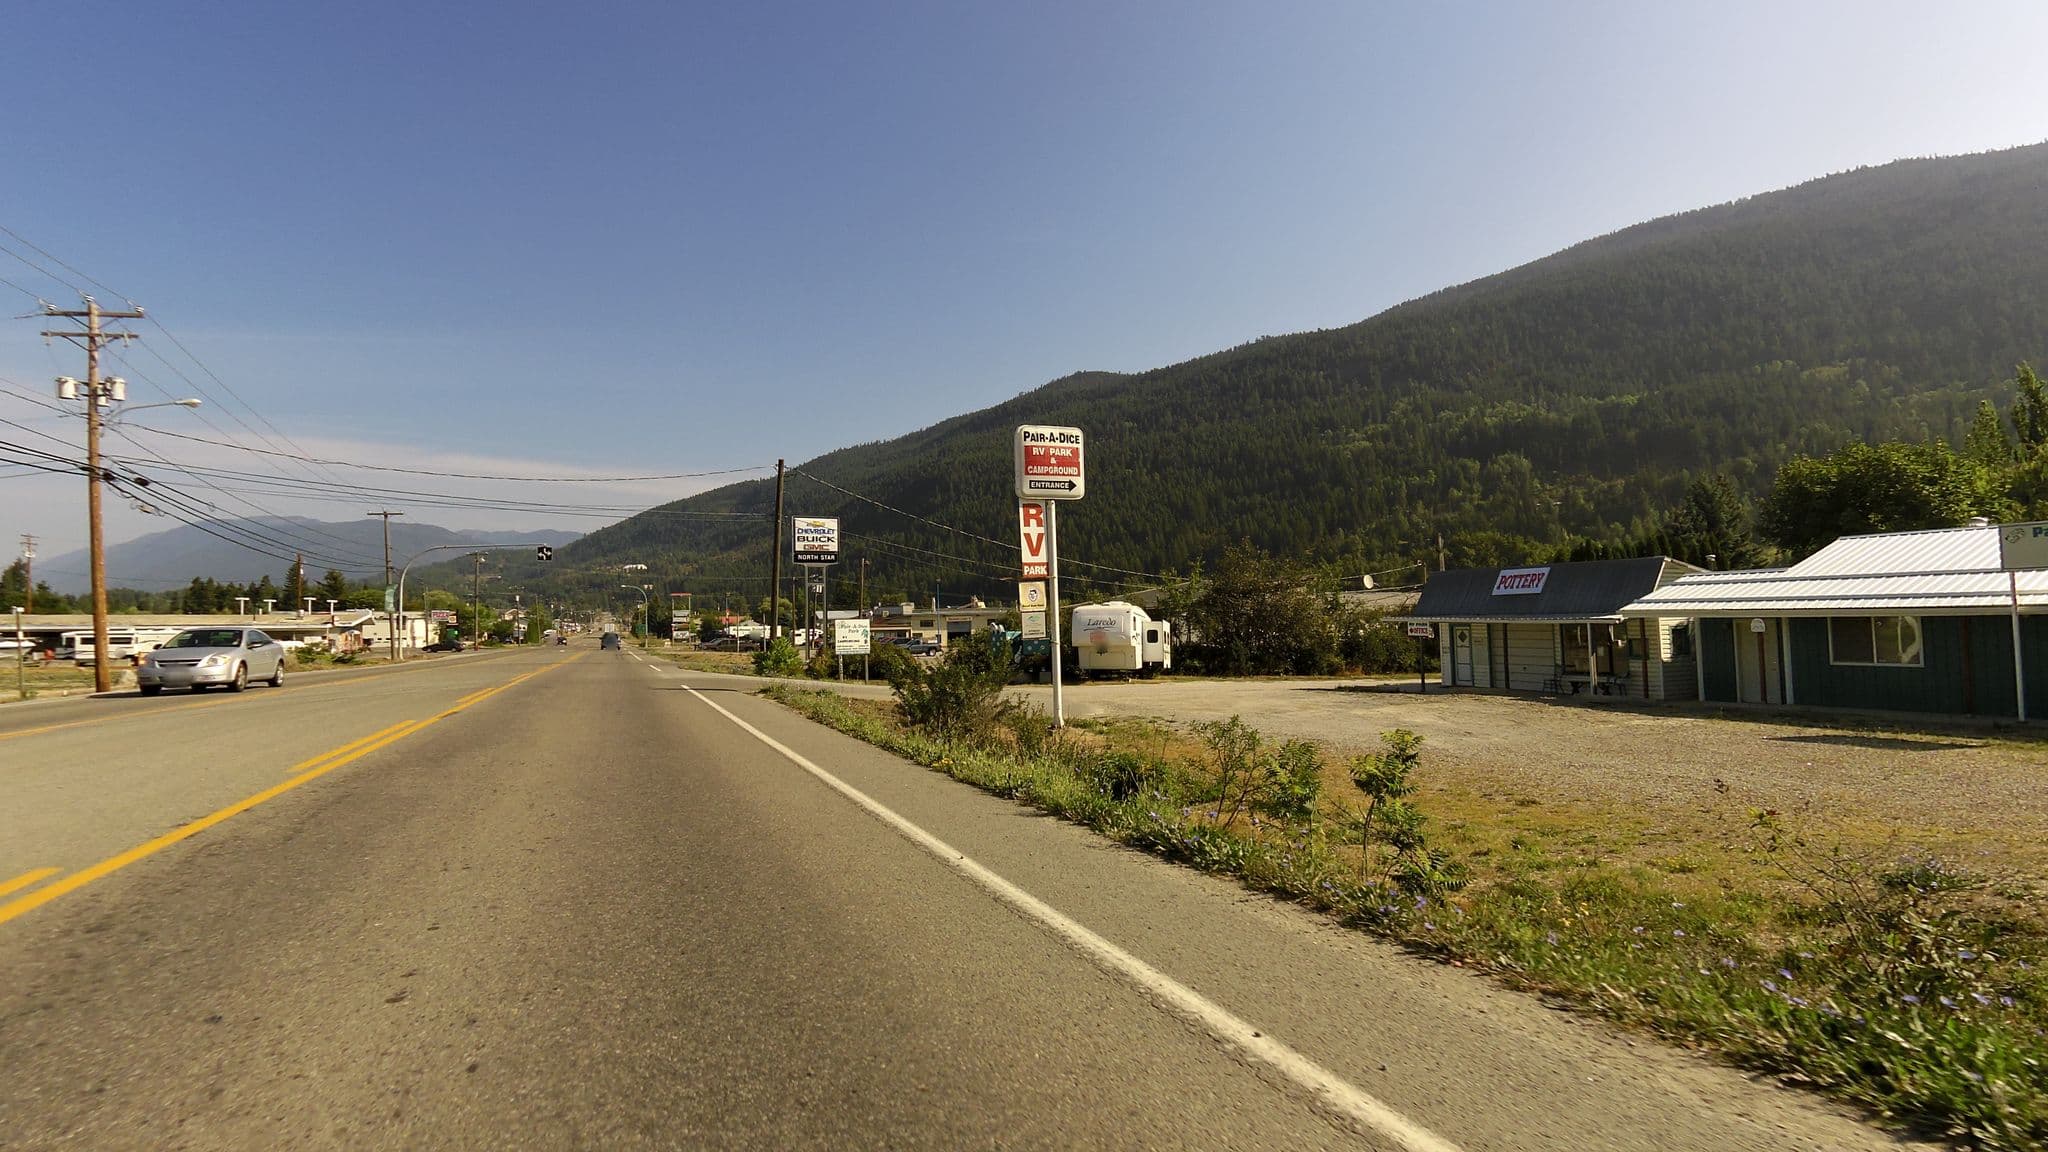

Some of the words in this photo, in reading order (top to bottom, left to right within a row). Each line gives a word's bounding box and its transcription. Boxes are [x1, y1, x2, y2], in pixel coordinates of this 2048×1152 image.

[1032, 447, 1045, 456] RV
[1049, 447, 1073, 457] PARK
[1027, 465, 1078, 475] CAMPGROUND
[1030, 481, 1070, 489] ENTRANCE
[1023, 565, 1048, 576] PARK
[1496, 572, 1545, 591] POTTERY
[1087, 617, 1117, 627] Laredo
